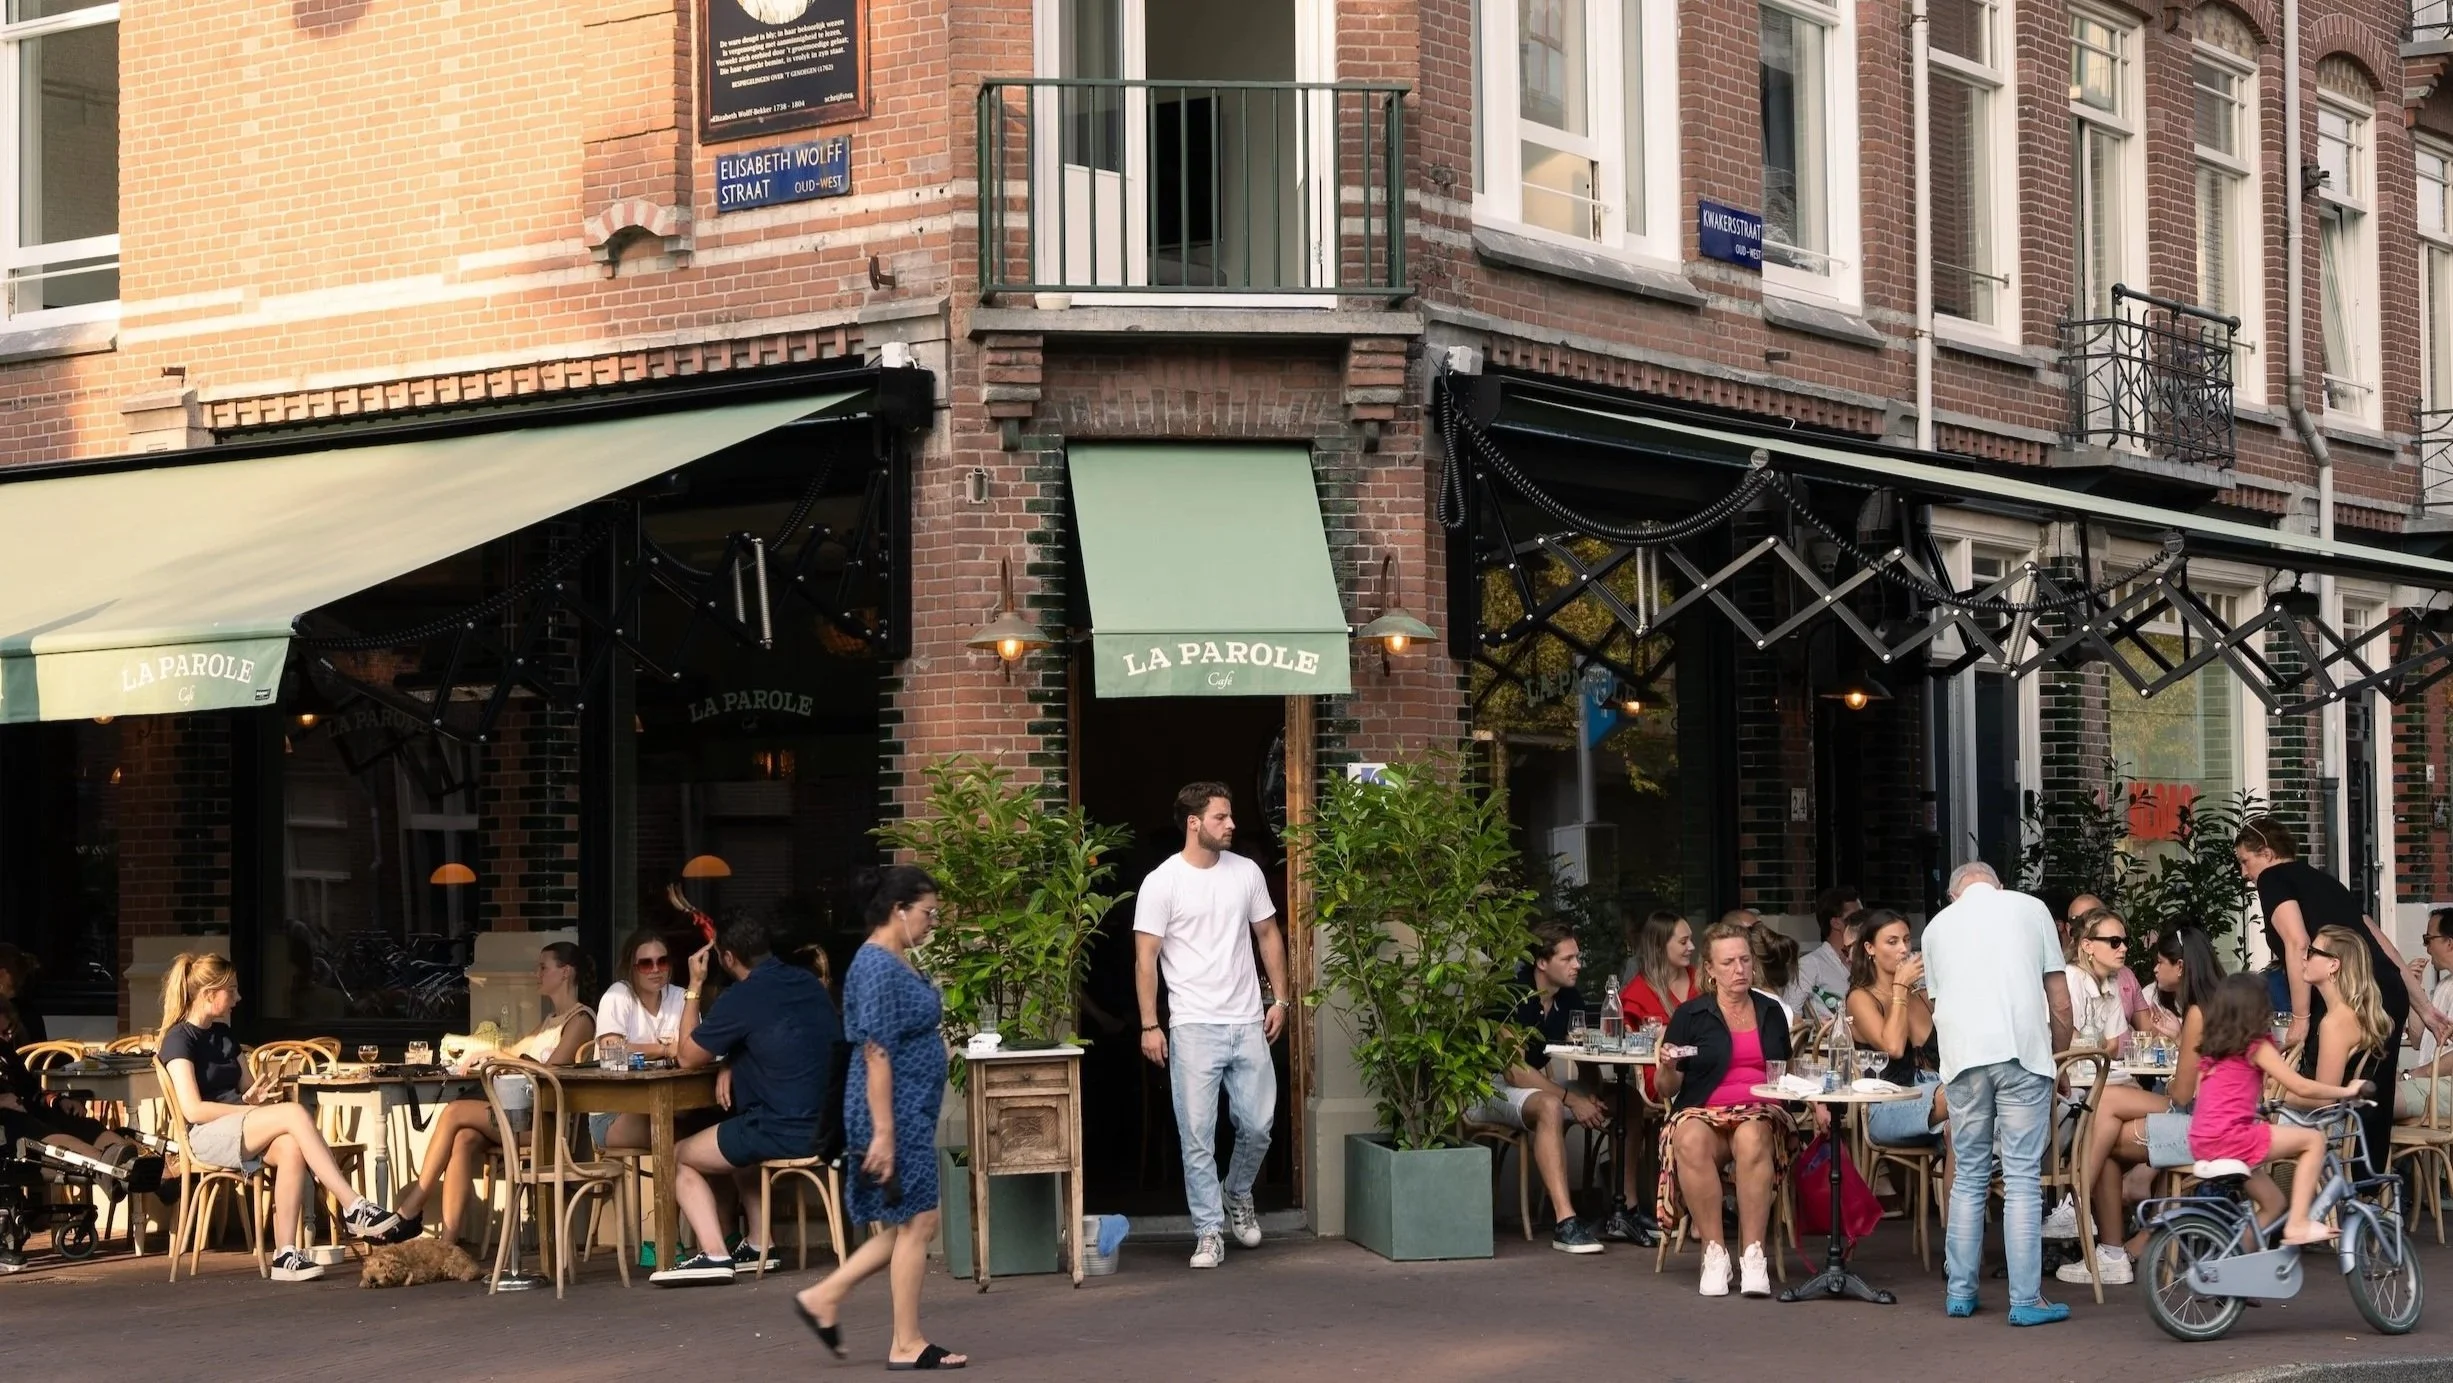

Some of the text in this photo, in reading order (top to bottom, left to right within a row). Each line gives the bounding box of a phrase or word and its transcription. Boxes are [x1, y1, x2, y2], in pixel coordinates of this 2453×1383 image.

[715, 57, 737, 66] Verwekt
[738, 54, 750, 62] zich
[742, 61, 763, 71] oprecht
[790, 67, 816, 77] GENOEGEN
[791, 100, 805, 108] 1804
[721, 143, 843, 180] ELISABETH WOLFF
[722, 179, 770, 205] STRAAT
[795, 175, 843, 194] OUD-WEST
[1703, 209, 1761, 240] KWAKERSSTRAAT
[1735, 244, 1761, 260] OUD-WEST
[1123, 641, 1320, 676] LA PAROLE
[122, 653, 255, 692] LA PAROLE
[1208, 670, 1235, 689] Café
[688, 696, 720, 724] LA
[722, 689, 814, 717] PAROLE
